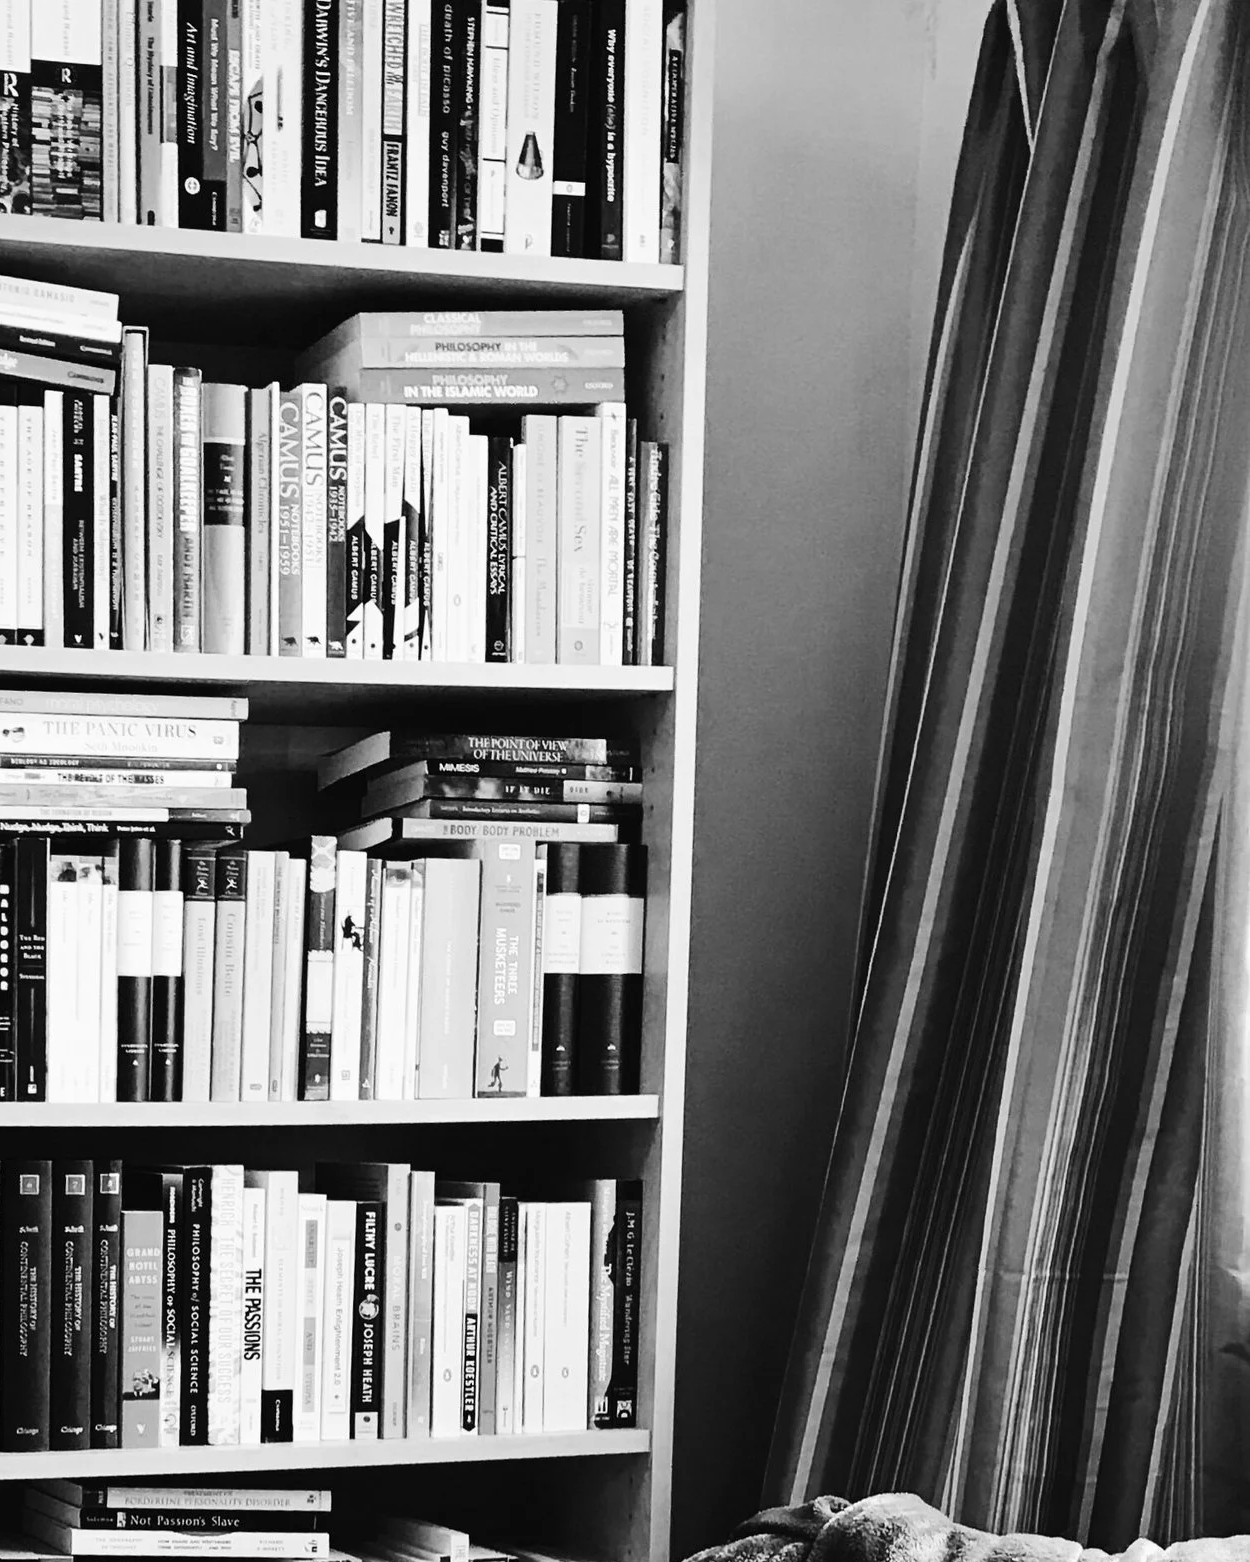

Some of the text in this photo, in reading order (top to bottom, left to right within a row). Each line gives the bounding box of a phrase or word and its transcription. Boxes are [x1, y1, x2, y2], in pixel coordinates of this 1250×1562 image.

[184, 22, 200, 144] Art and Imagination
[304, 391, 324, 487] CAMUS
[329, 398, 346, 480] CAMUS
[279, 403, 300, 576] CAMUS NOTEBOOKS
[349, 535, 360, 600] ALBERT CAMUS
[42, 721, 197, 739] THE PANIC VIRUS
[493, 928, 507, 1004] MUSKETEERS
[507, 936, 519, 994] THE THREE
[190, 1224, 200, 1394] PHILOSOPHY SOCIAL SCIENCE
[243, 1269, 262, 1361] THE PASSIONS
[362, 1212, 376, 1402] FILTHY LUCRE JOSEPH HEATH
[464, 1318, 477, 1411] ARTHUR KOESTLER
[130, 1516, 239, 1527] Not Passion's Slave
